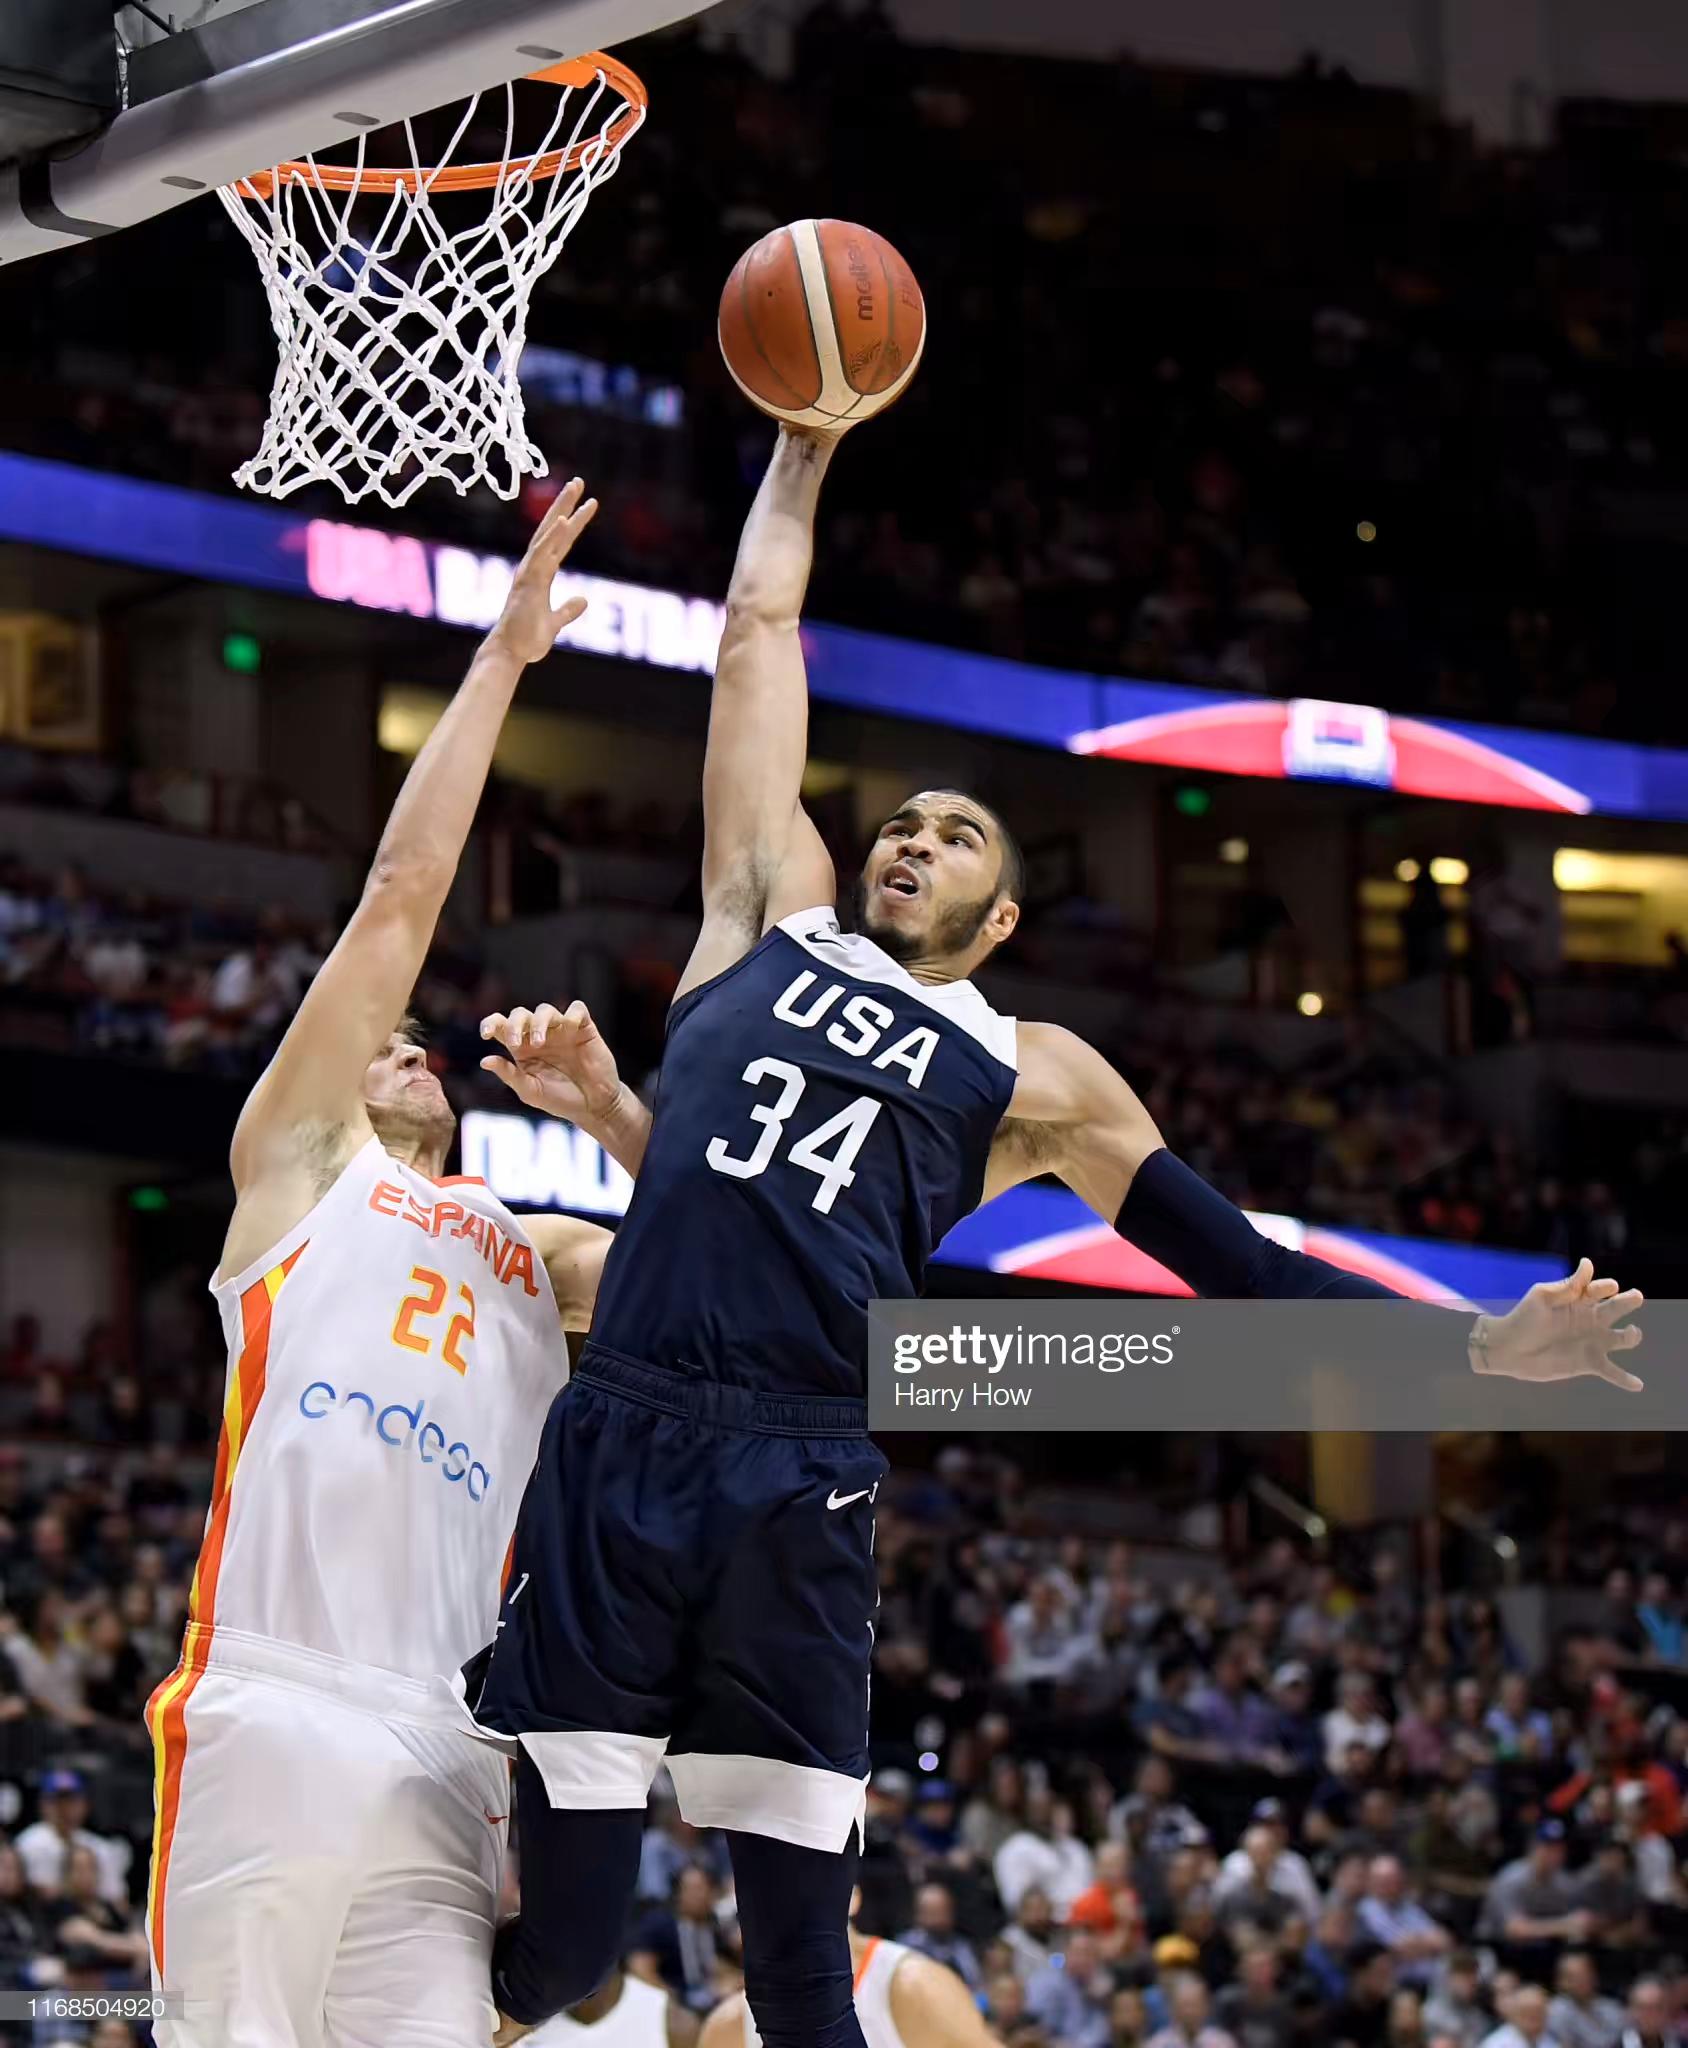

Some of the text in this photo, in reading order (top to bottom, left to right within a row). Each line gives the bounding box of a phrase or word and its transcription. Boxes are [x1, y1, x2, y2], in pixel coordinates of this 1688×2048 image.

[772, 969, 941, 1090] USA
[705, 1056, 883, 1215] 34
[391, 1264, 477, 1378] 22
[299, 1381, 491, 1502] endesa
